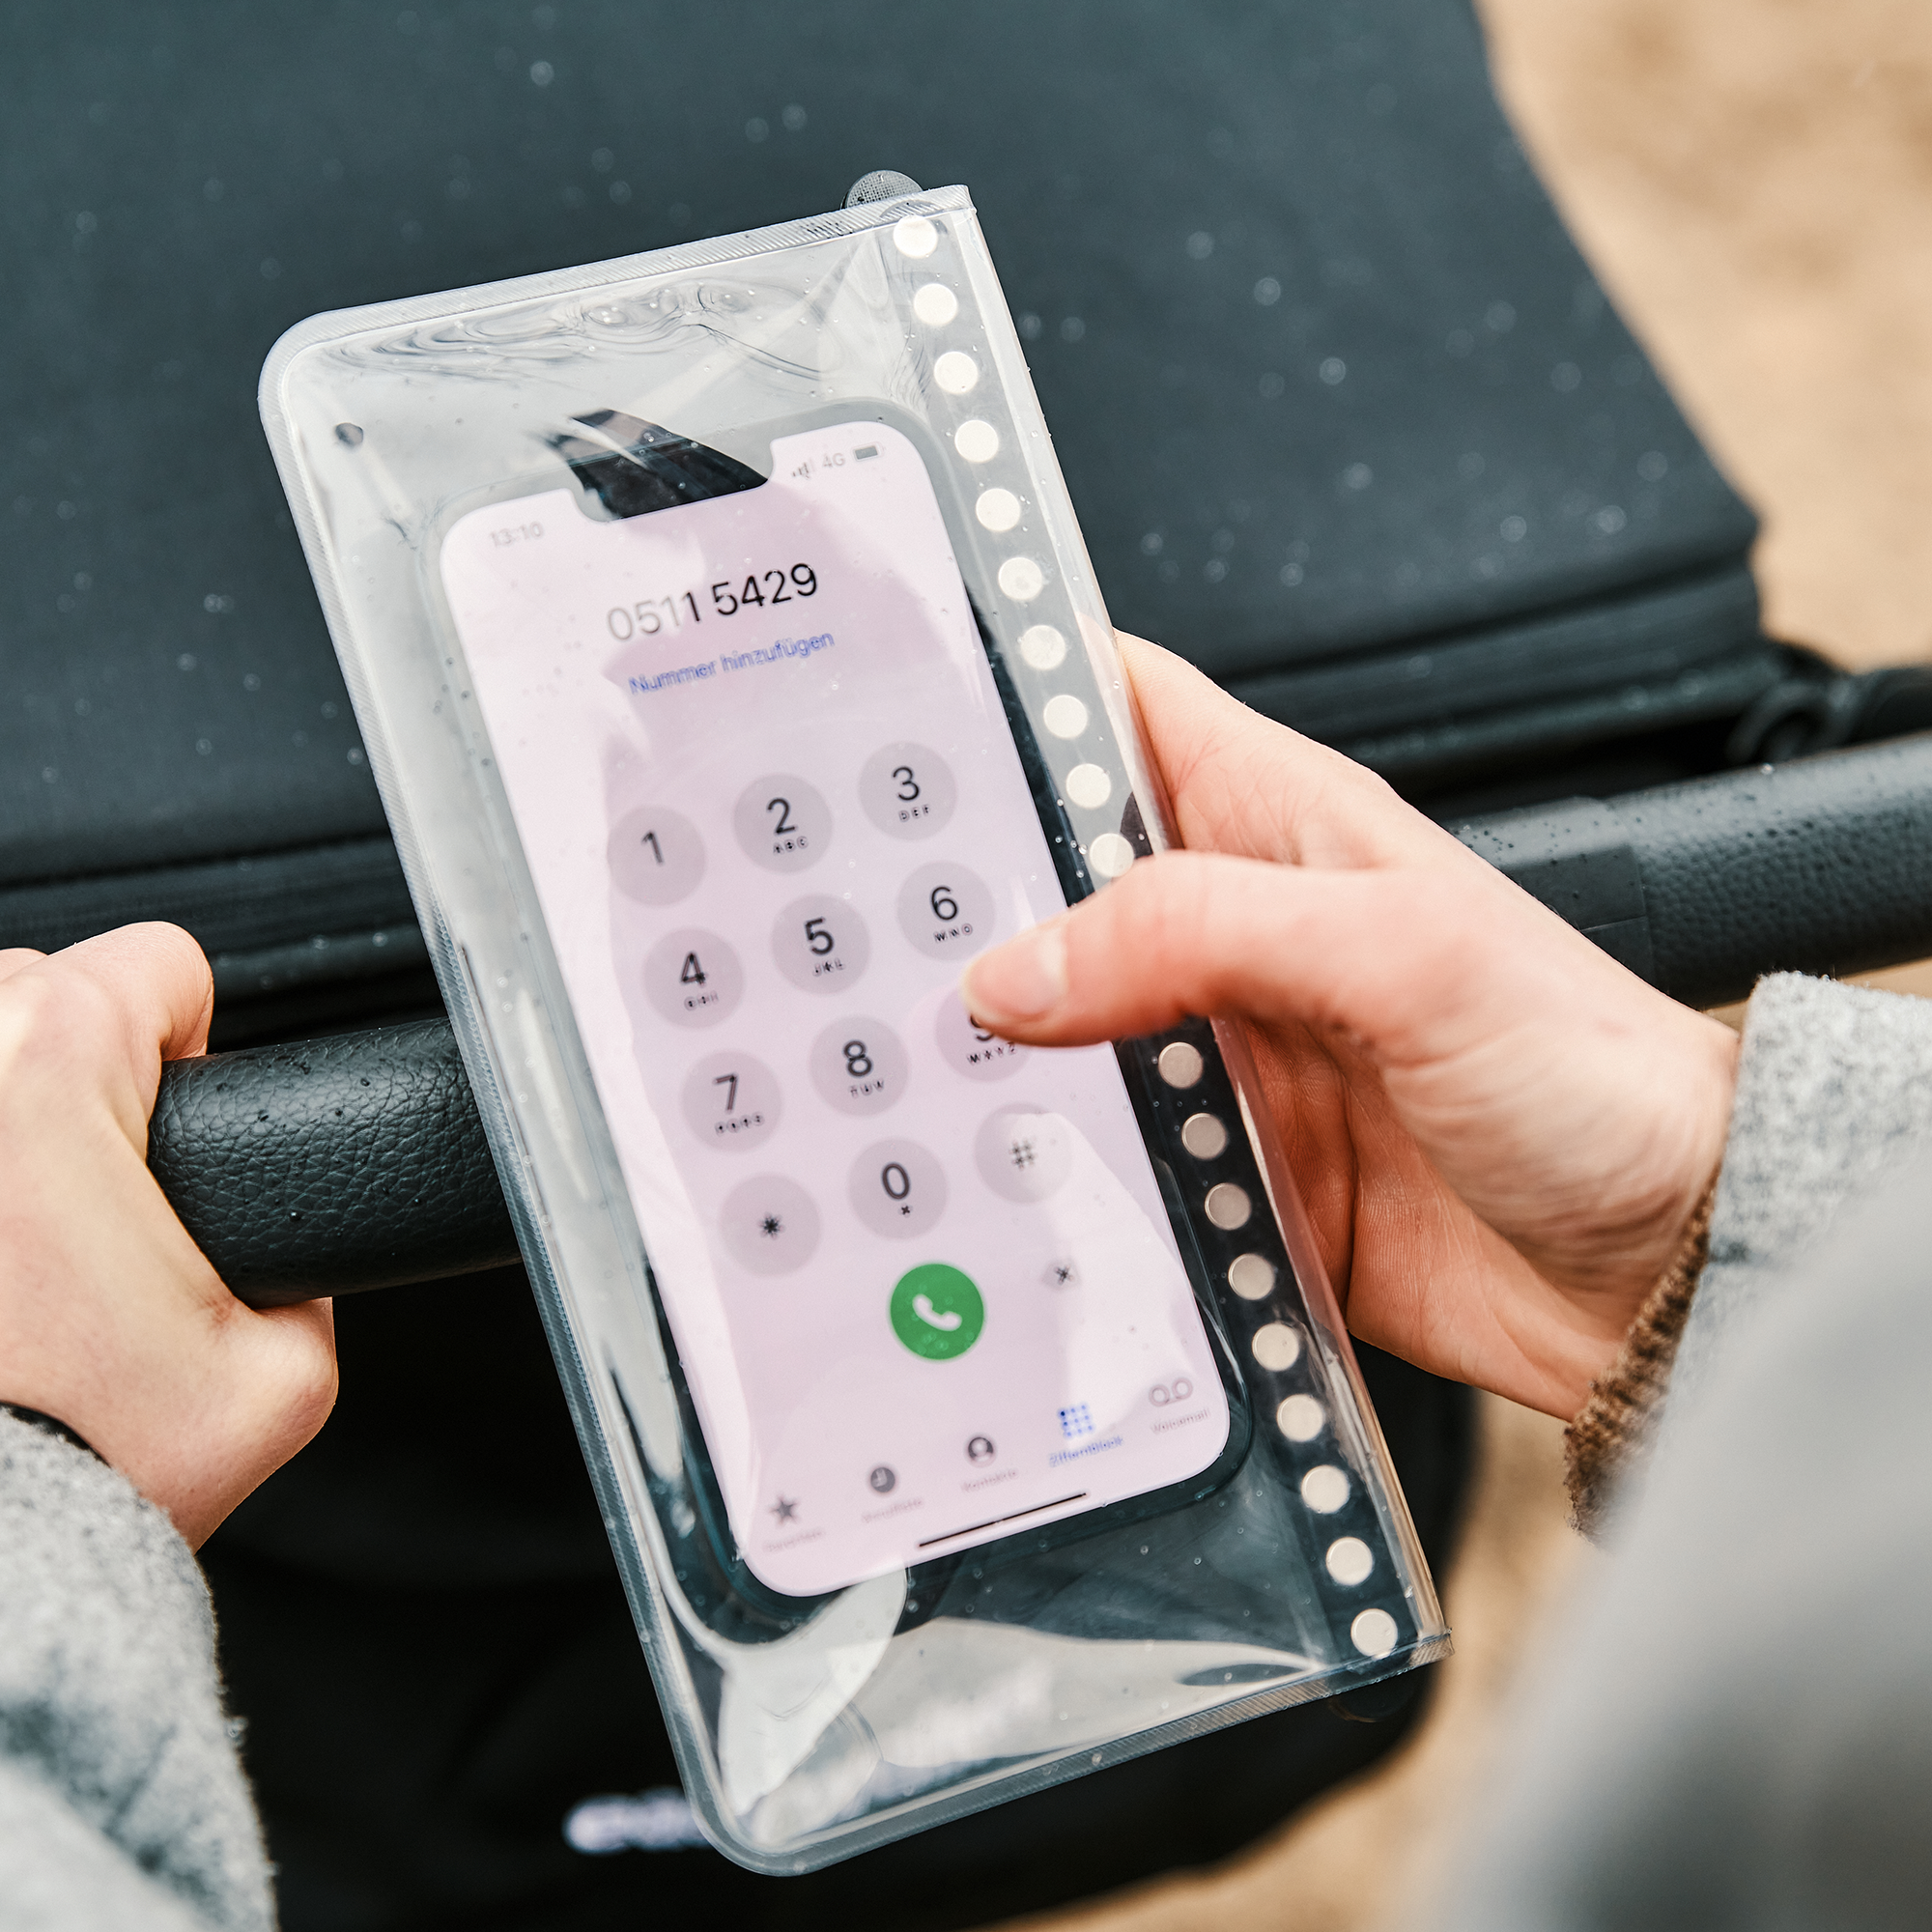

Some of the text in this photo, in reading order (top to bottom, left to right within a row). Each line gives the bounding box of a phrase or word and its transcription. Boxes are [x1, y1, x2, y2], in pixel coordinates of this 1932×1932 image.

[822, 452, 846, 469] 4G
[607, 563, 817, 641] 0511 5429
[628, 631, 836, 696] Nummer hinzufügen
[892, 765, 921, 802] 3
[766, 797, 798, 836] 2
[898, 804, 930, 822] DEF
[641, 830, 664, 865] 1
[929, 885, 959, 922] 6
[804, 916, 835, 956] 5
[679, 951, 706, 984] 4
[842, 1039, 873, 1077] 8
[713, 1072, 737, 1113] 7
[881, 1162, 911, 1201] 0
